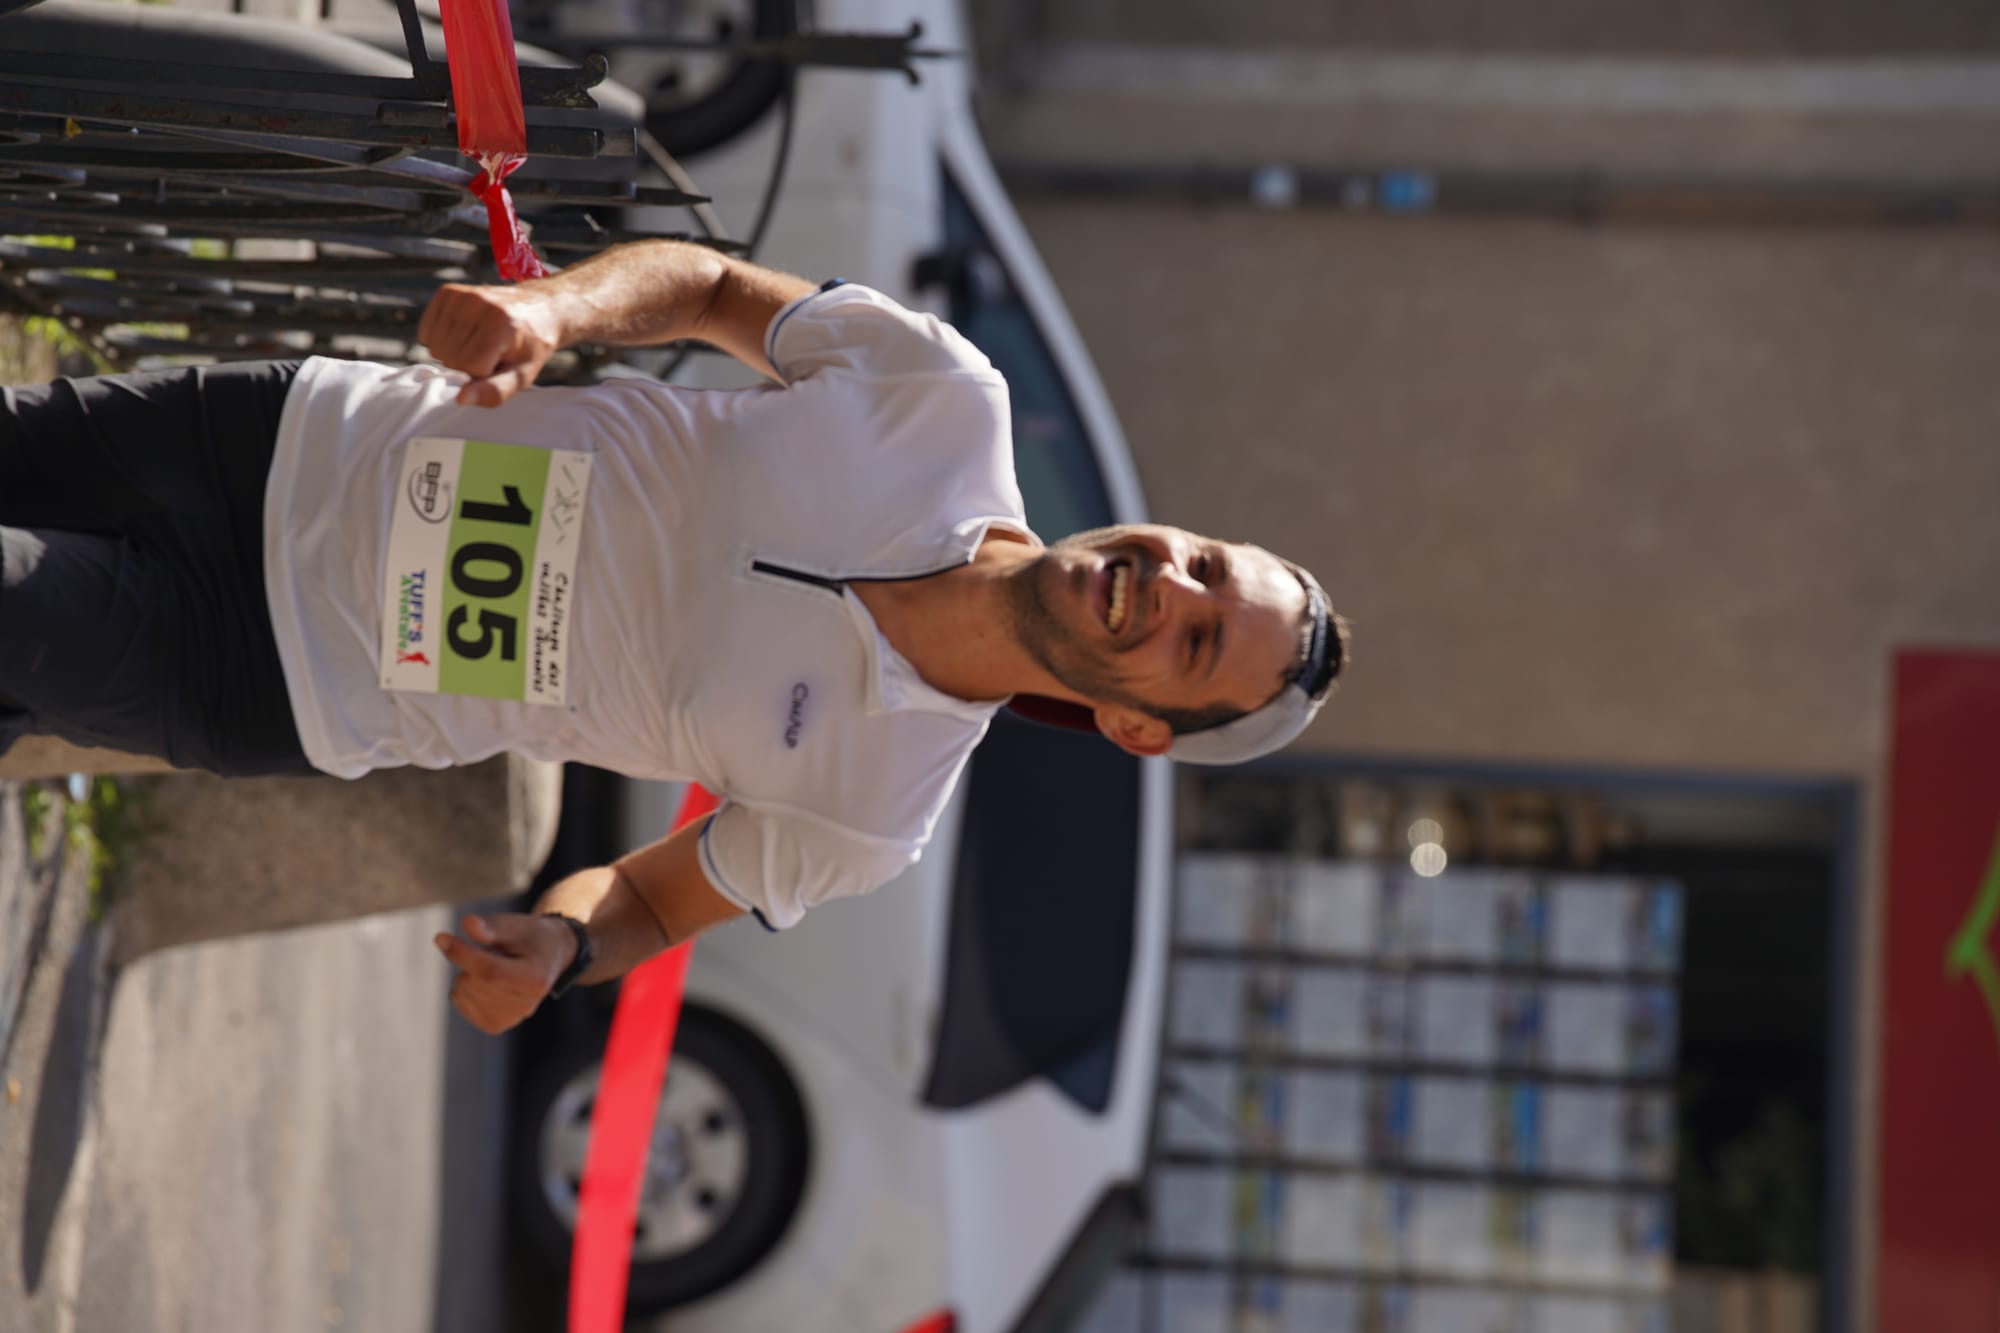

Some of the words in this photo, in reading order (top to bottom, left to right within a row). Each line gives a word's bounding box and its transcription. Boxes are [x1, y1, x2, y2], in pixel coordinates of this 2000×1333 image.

[409, 569, 426, 643] TUFF'S
[446, 485, 533, 662] 105
[545, 572, 568, 651] Challenge
[548, 661, 560, 688] des
